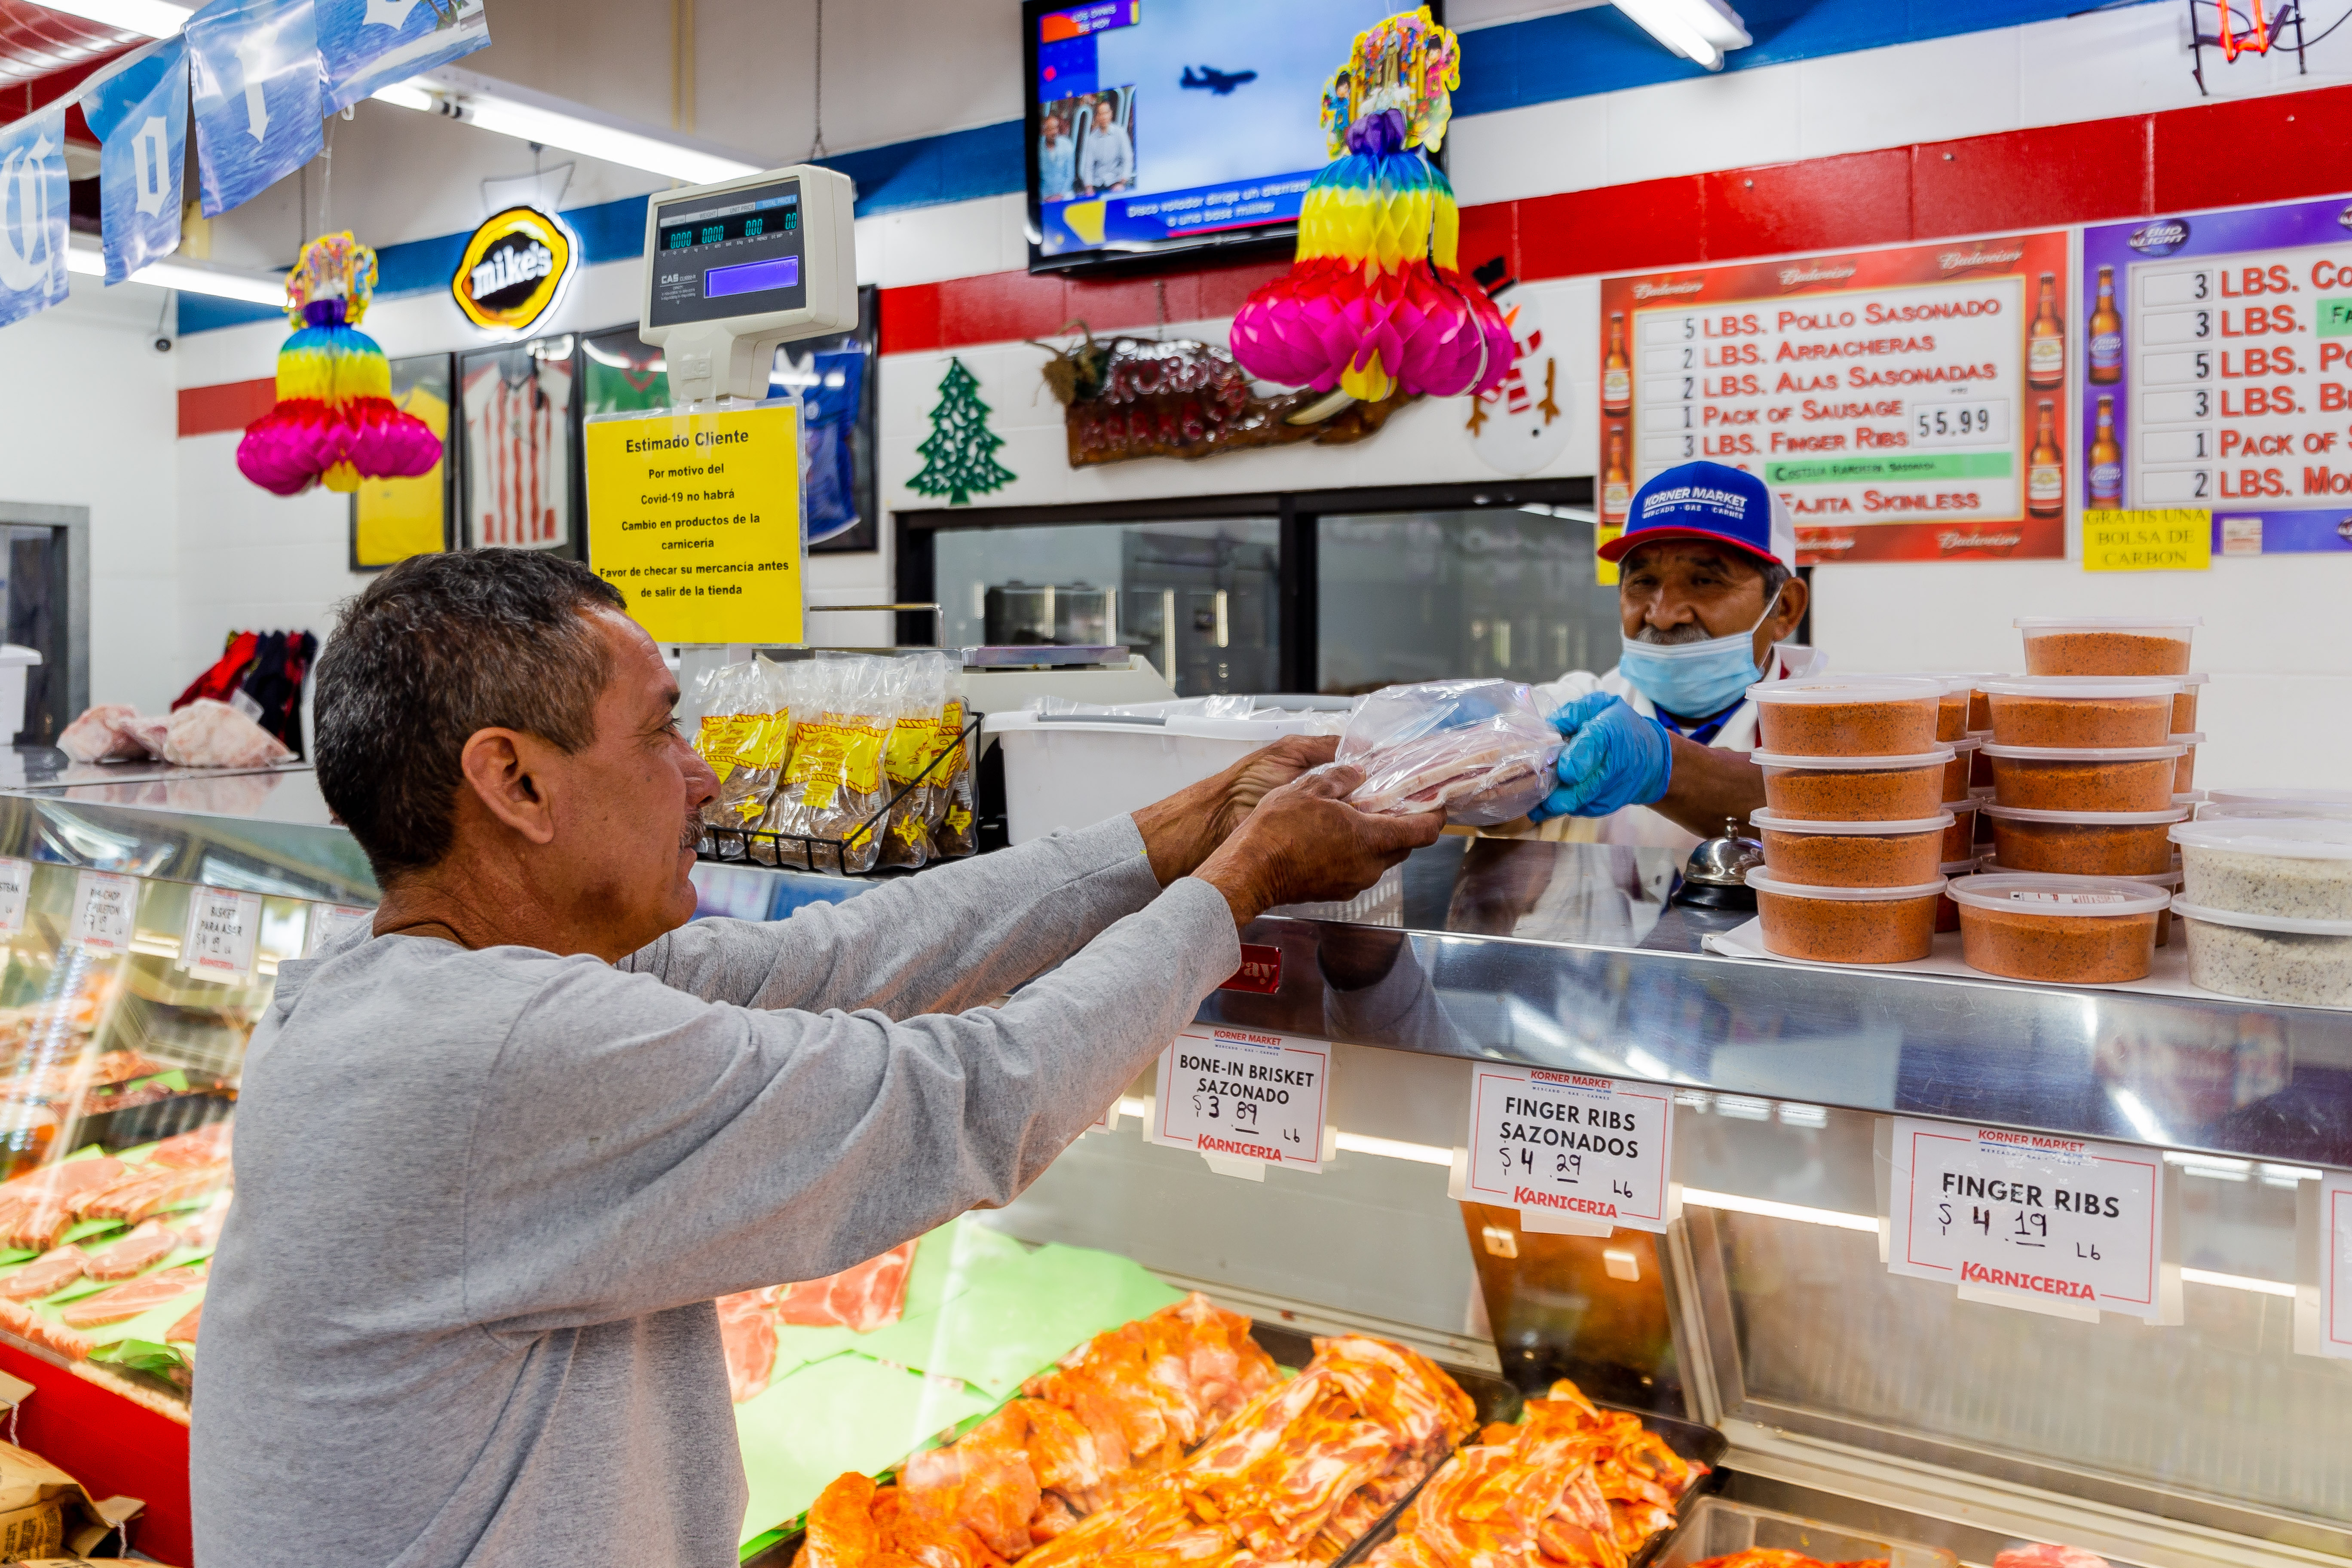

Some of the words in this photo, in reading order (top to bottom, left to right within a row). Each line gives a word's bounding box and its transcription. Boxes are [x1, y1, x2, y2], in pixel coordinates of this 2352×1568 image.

[2136, 234, 2186, 246] LIGHT
[2148, 224, 2183, 237] BUD
[471, 240, 553, 300] mike's
[662, 273, 679, 284] CAS
[2196, 273, 2206, 299] 3
[2221, 265, 2299, 298] LBS.
[1684, 318, 1694, 340] 5
[1703, 314, 1767, 337] LBS.
[2196, 312, 2209, 337] 3
[2221, 304, 2306, 337] LBS.
[1683, 349, 1693, 369] 2
[1703, 344, 1767, 367] LBS.
[2196, 352, 2209, 378] 5
[2221, 346, 2306, 378] LBS.
[1683, 377, 1693, 399] 2
[1703, 374, 1767, 398] LBS.
[2196, 391, 2208, 416] 3
[2221, 386, 2306, 417] LBS.
[1684, 406, 1693, 428] 1
[626, 434, 689, 453] Estimado
[695, 430, 749, 446] Cliente
[1684, 435, 1694, 457] 3
[2196, 433, 2208, 458] 1
[649, 469, 665, 479] Por
[668, 466, 704, 477] motivo
[707, 463, 725, 474] del
[2195, 472, 2208, 498] 2
[2220, 468, 2292, 498] LBS.
[641, 492, 683, 505] Covid-19
[687, 493, 700, 502] no
[704, 488, 735, 500] habrá
[1644, 487, 1690, 508] KORNER
[1692, 487, 1748, 507] MARKET
[622, 519, 657, 531] Cambio
[660, 520, 672, 529] en
[675, 515, 729, 530] productos
[733, 514, 747, 524] de
[750, 513, 760, 523] la
[662, 538, 714, 550] carnicería
[2098, 531, 2161, 545] BOLSA
[2169, 530, 2196, 543] DE
[600, 568, 627, 579] Favor
[630, 566, 641, 577] de
[644, 564, 677, 576] checar
[680, 565, 693, 575] su
[695, 560, 754, 574] mercancía
[757, 560, 790, 571] antes
[2105, 551, 2187, 567] CARBON
[640, 588, 652, 598] de
[655, 586, 677, 597] salir
[679, 585, 692, 596] de
[695, 585, 704, 596] la
[708, 585, 743, 595] tienda
[1214, 1030, 1247, 1041] KORNER
[1248, 1034, 1282, 1046] MARKET
[1180, 1054, 1244, 1077] BONE-IN
[1249, 1064, 1315, 1087] BRISKET
[1531, 1070, 1569, 1084] KORNER
[1572, 1076, 1613, 1089] MARKET
[1197, 1077, 1289, 1105] SAZONADO
[1505, 1096, 1581, 1124] FINGER
[1588, 1107, 1636, 1132] RIBS
[1197, 1133, 1283, 1161] KARNICERIA
[1499, 1122, 1638, 1158] SAZONADOS
[1978, 1129, 2029, 1145] KORNER
[2032, 1136, 2085, 1152] MARKET
[1513, 1185, 1618, 1219] KARNICERIA
[1942, 1173, 2043, 1207] FINGER
[2055, 1188, 2120, 1218] RIBS
[1960, 1261, 2096, 1302] KARNICERIA
